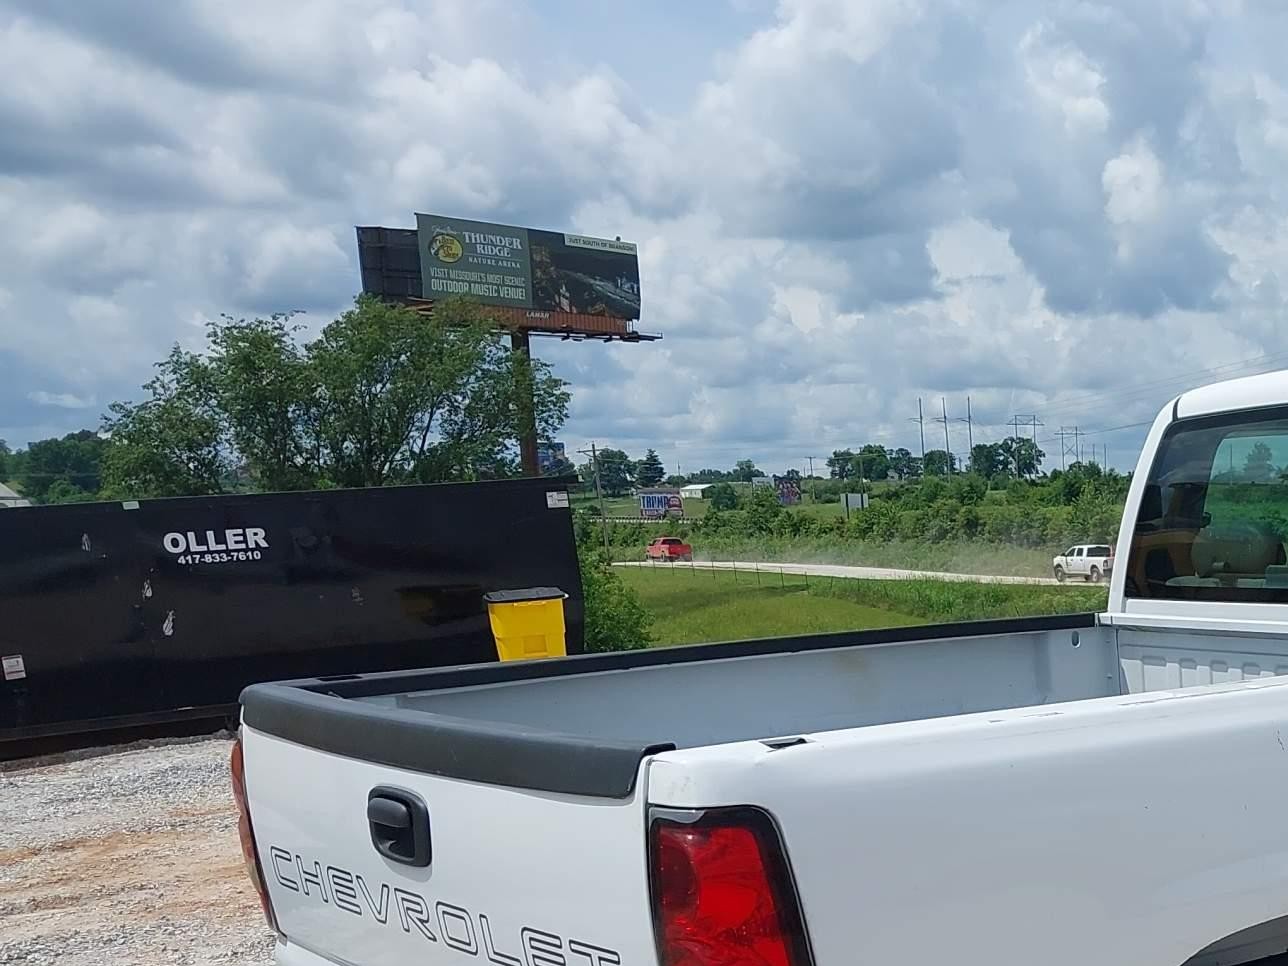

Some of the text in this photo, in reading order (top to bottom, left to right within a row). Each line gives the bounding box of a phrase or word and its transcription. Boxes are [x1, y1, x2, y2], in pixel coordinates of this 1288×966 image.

[462, 231, 523, 250] THUNDER
[476, 243, 511, 258] RIDGE
[468, 256, 521, 269] NATURE ARENA
[430, 267, 449, 278] VISIT
[487, 272, 503, 284] MOST
[431, 278, 527, 300] OUTDOOR MUSIC VENUE!
[640, 496, 669, 509] TRUMP
[163, 527, 269, 554] OLLER
[178, 551, 261, 564] 417-833-7610
